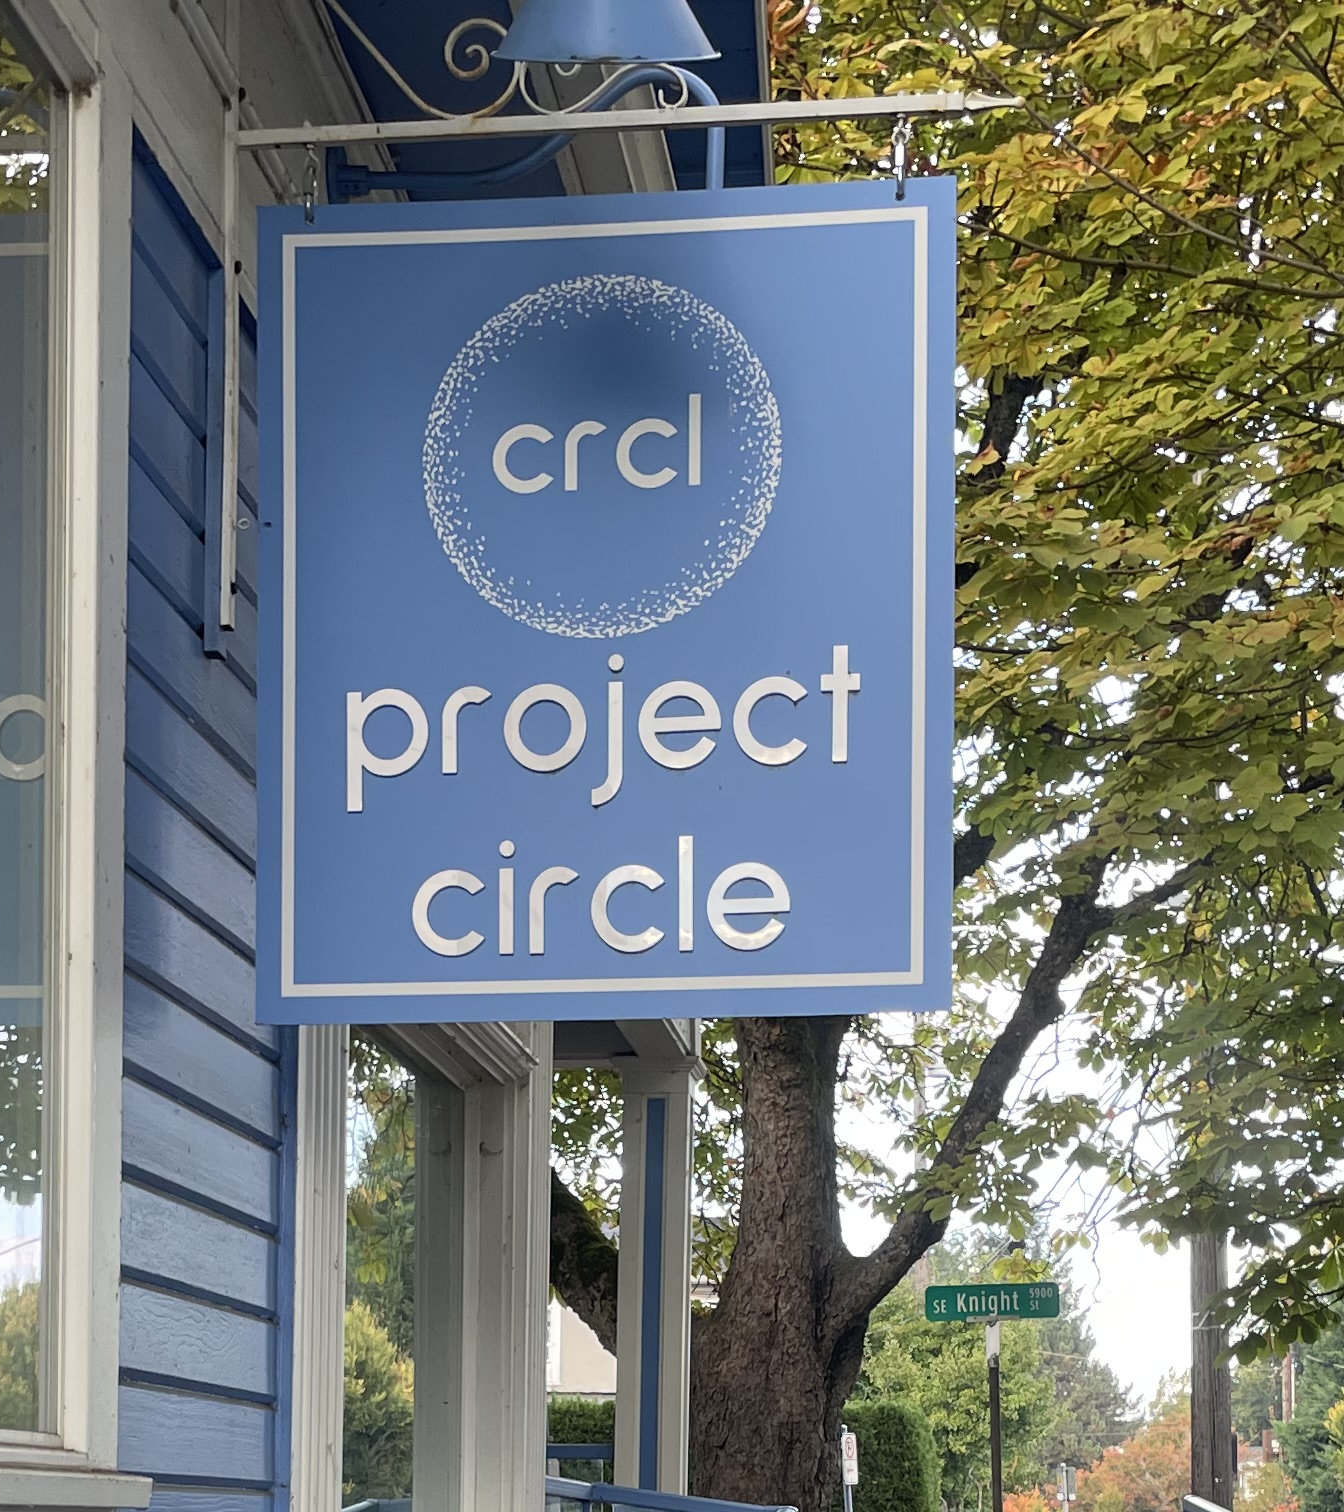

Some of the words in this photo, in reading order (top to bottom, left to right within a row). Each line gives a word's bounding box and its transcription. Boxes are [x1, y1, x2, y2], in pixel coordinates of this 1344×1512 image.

[492, 393, 702, 494] crcl
[346, 645, 861, 813] project
[412, 835, 791, 957] circle
[933, 1300, 947, 1314] SE
[957, 1290, 1019, 1315] Knight
[1030, 1300, 1039, 1311] St
[1029, 1288, 1052, 1298] 5900
